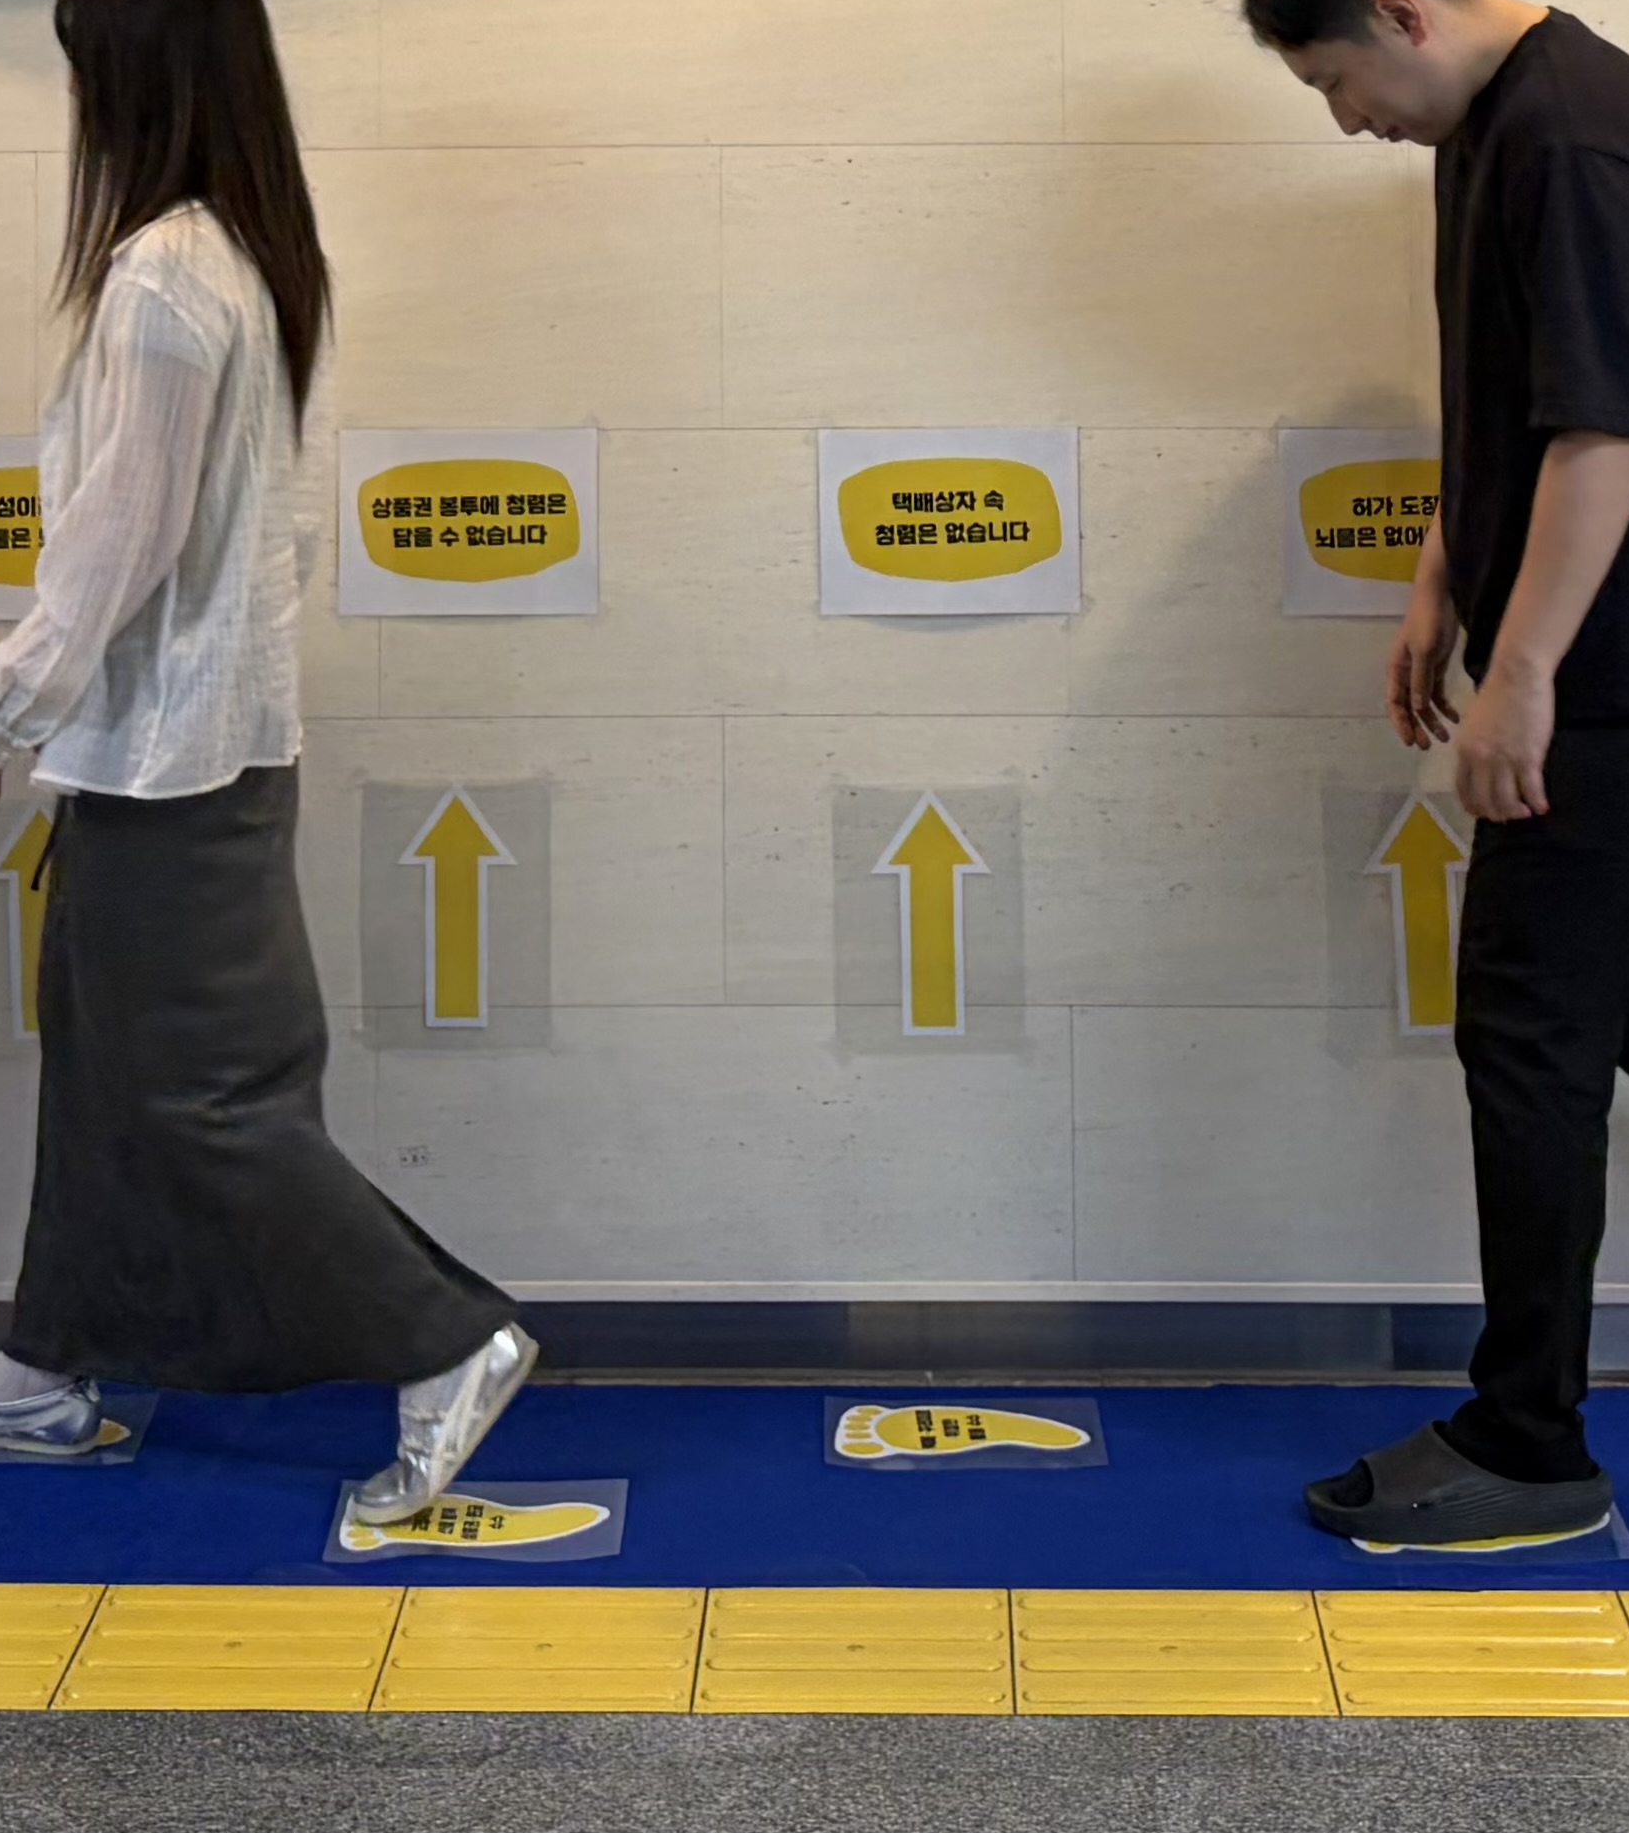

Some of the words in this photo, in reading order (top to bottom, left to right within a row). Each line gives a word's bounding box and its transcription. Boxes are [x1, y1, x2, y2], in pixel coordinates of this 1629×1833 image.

[372, 497, 432, 518] 상품권
[440, 496, 499, 516] 봉투에
[507, 494, 566, 515] 청렴은
[892, 491, 976, 513] 택배상자
[984, 490, 1003, 511] 속
[1353, 496, 1393, 516] 허가
[393, 527, 432, 548] 담을
[440, 527, 459, 547] 수
[466, 525, 547, 546] 없습니다
[876, 524, 937, 545] 청렴은
[945, 521, 1029, 544] 없습니다
[1384, 526, 1428, 548] 없어
